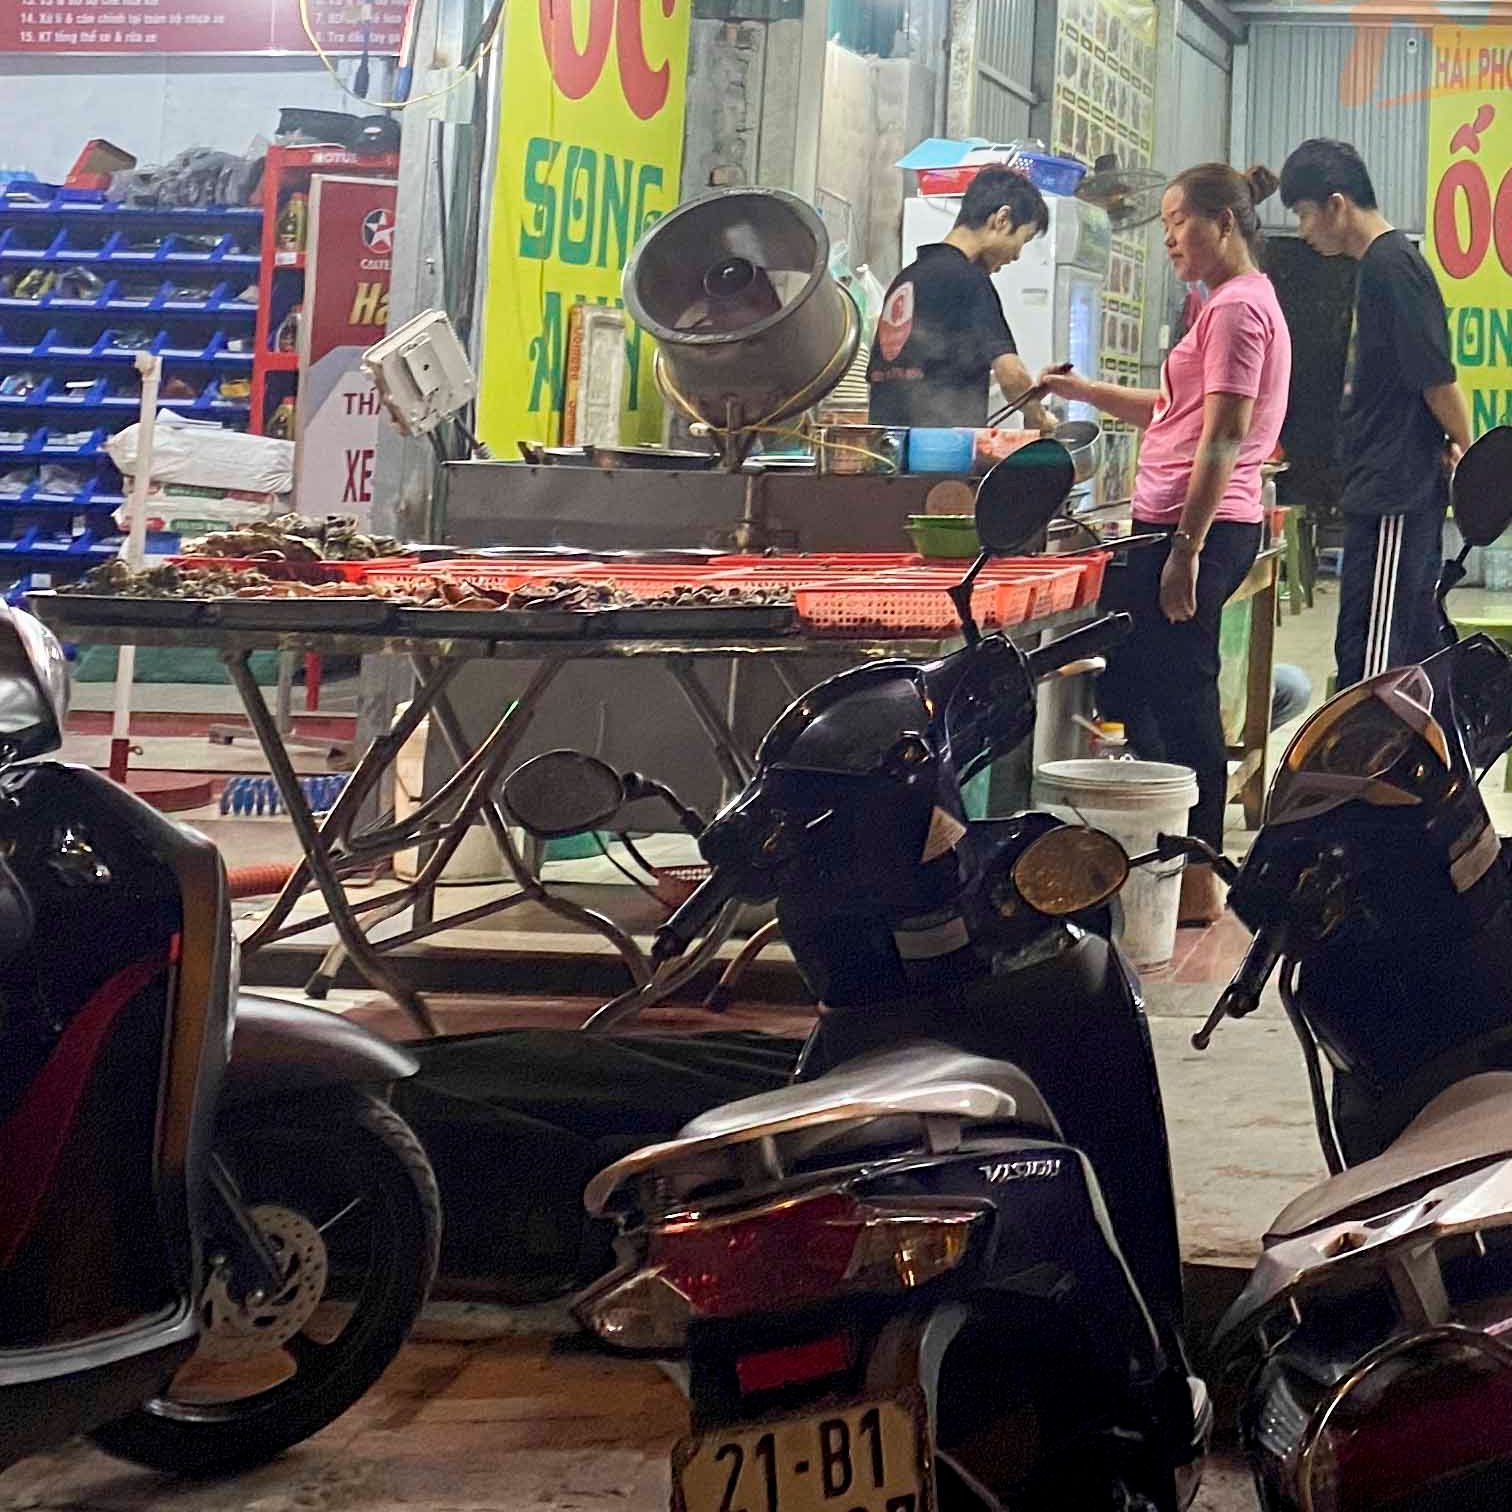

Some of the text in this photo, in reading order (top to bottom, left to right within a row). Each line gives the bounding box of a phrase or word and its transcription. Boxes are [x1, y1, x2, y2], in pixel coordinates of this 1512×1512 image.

[1435, 32, 1471, 89] HẢI
[978, 1159, 1060, 1183] VISION
[715, 1408, 885, 1512] 21-B1
